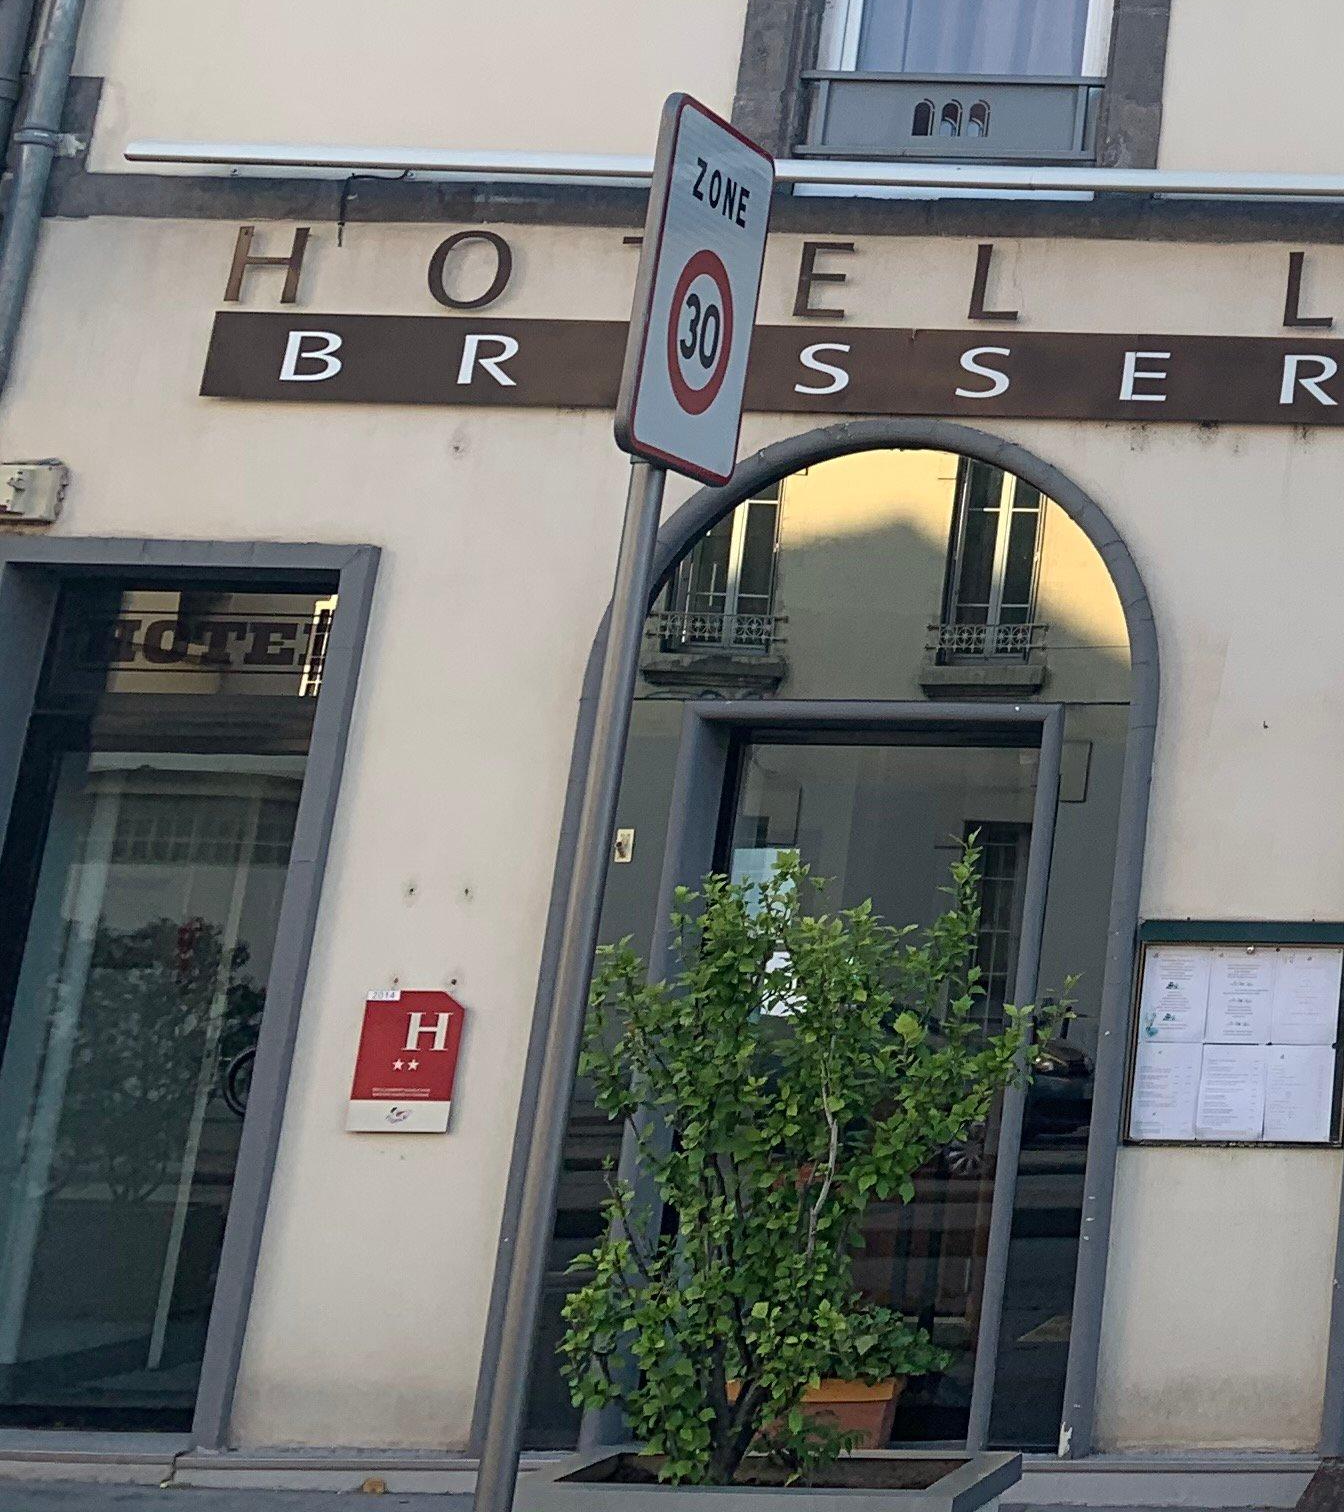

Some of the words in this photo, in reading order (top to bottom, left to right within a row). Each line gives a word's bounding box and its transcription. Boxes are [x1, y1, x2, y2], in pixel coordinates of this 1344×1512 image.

[692, 157, 750, 228] ZONE
[223, 225, 1018, 322] HOEL
[679, 293, 720, 369] 30
[402, 1012, 453, 1051] H
